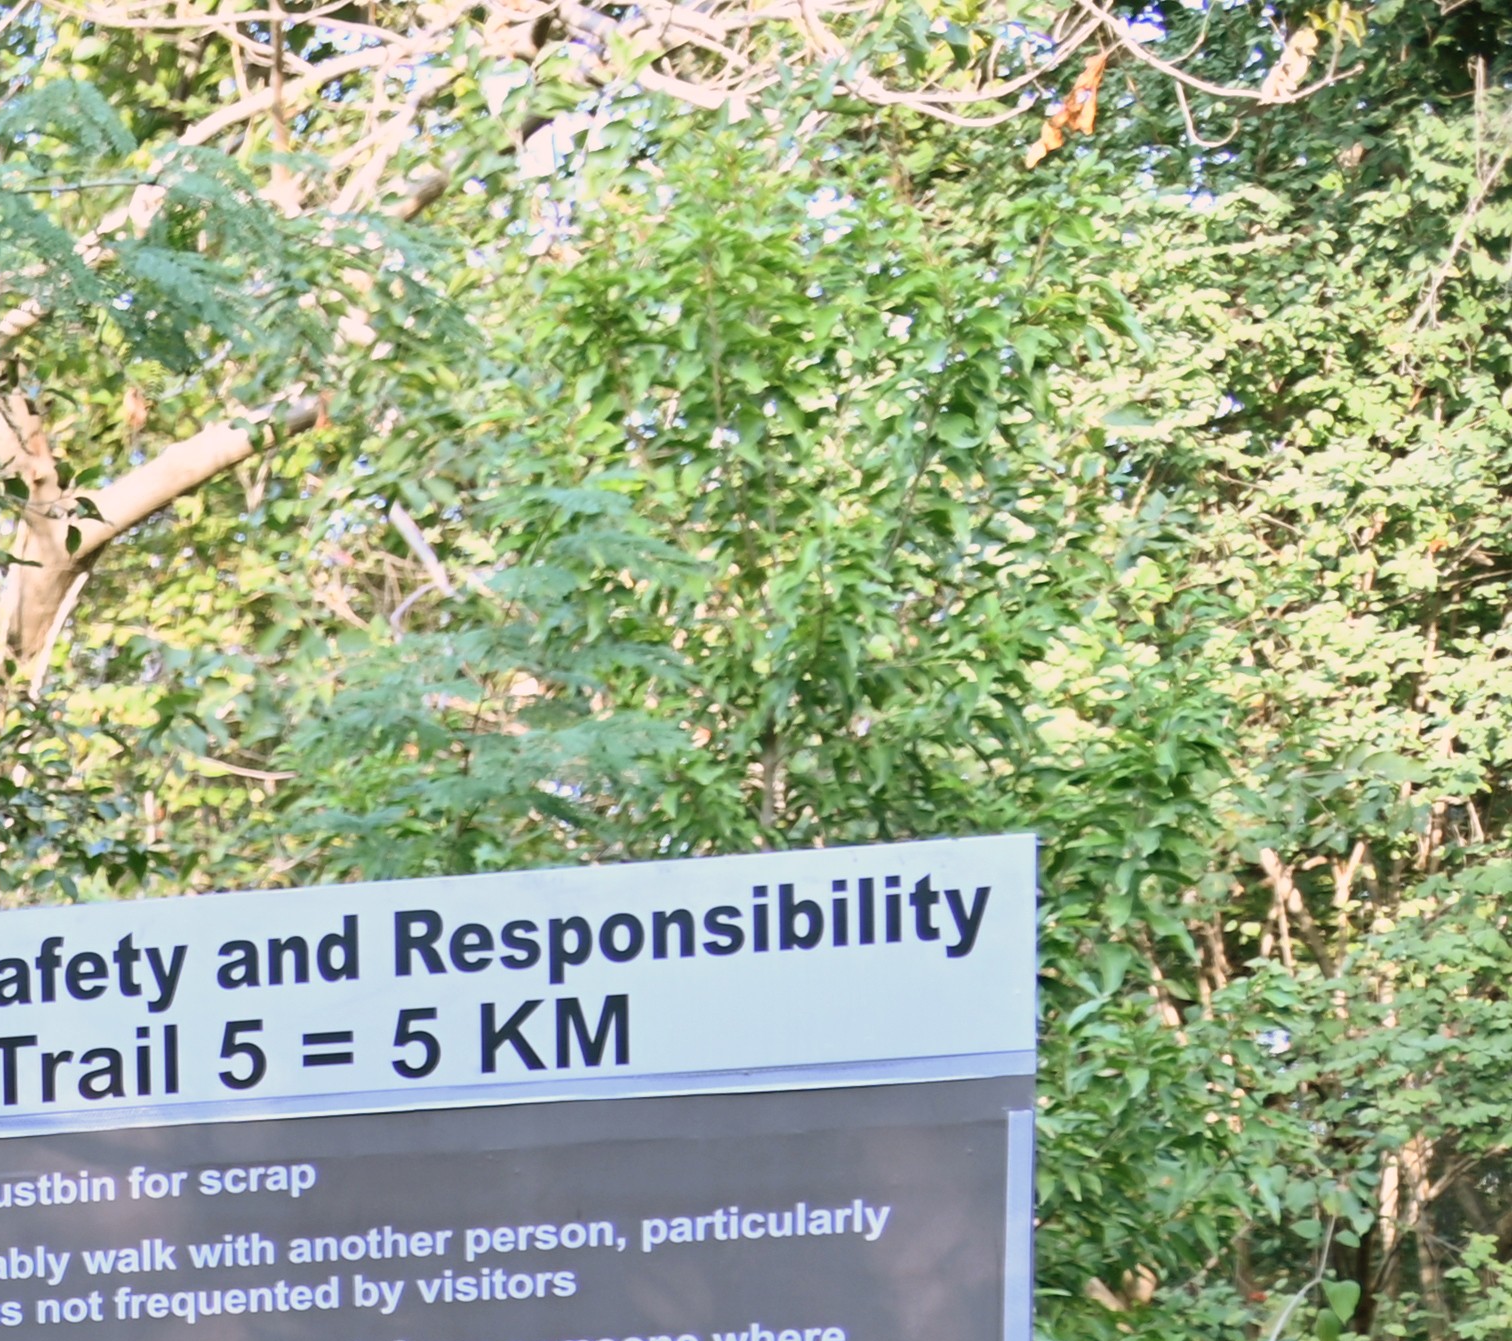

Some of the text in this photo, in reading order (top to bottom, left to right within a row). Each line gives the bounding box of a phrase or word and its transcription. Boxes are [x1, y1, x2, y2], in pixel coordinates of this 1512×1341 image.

[215, 912, 360, 992] and
[393, 875, 992, 987] Responsibility
[217, 1017, 268, 1092] 5
[301, 1028, 355, 1069] =
[390, 1005, 442, 1081] 5
[479, 992, 631, 1075] KM
[127, 1165, 188, 1200] for
[199, 1163, 316, 1198] scrap
[81, 1237, 177, 1276] walk
[188, 1232, 275, 1270] with
[288, 1225, 453, 1265] another
[465, 1221, 626, 1262] person,
[642, 1198, 891, 1254] particularly
[37, 1290, 104, 1325] not
[113, 1275, 339, 1325] frequented
[353, 1273, 405, 1315] by
[416, 1266, 577, 1304] visitors
